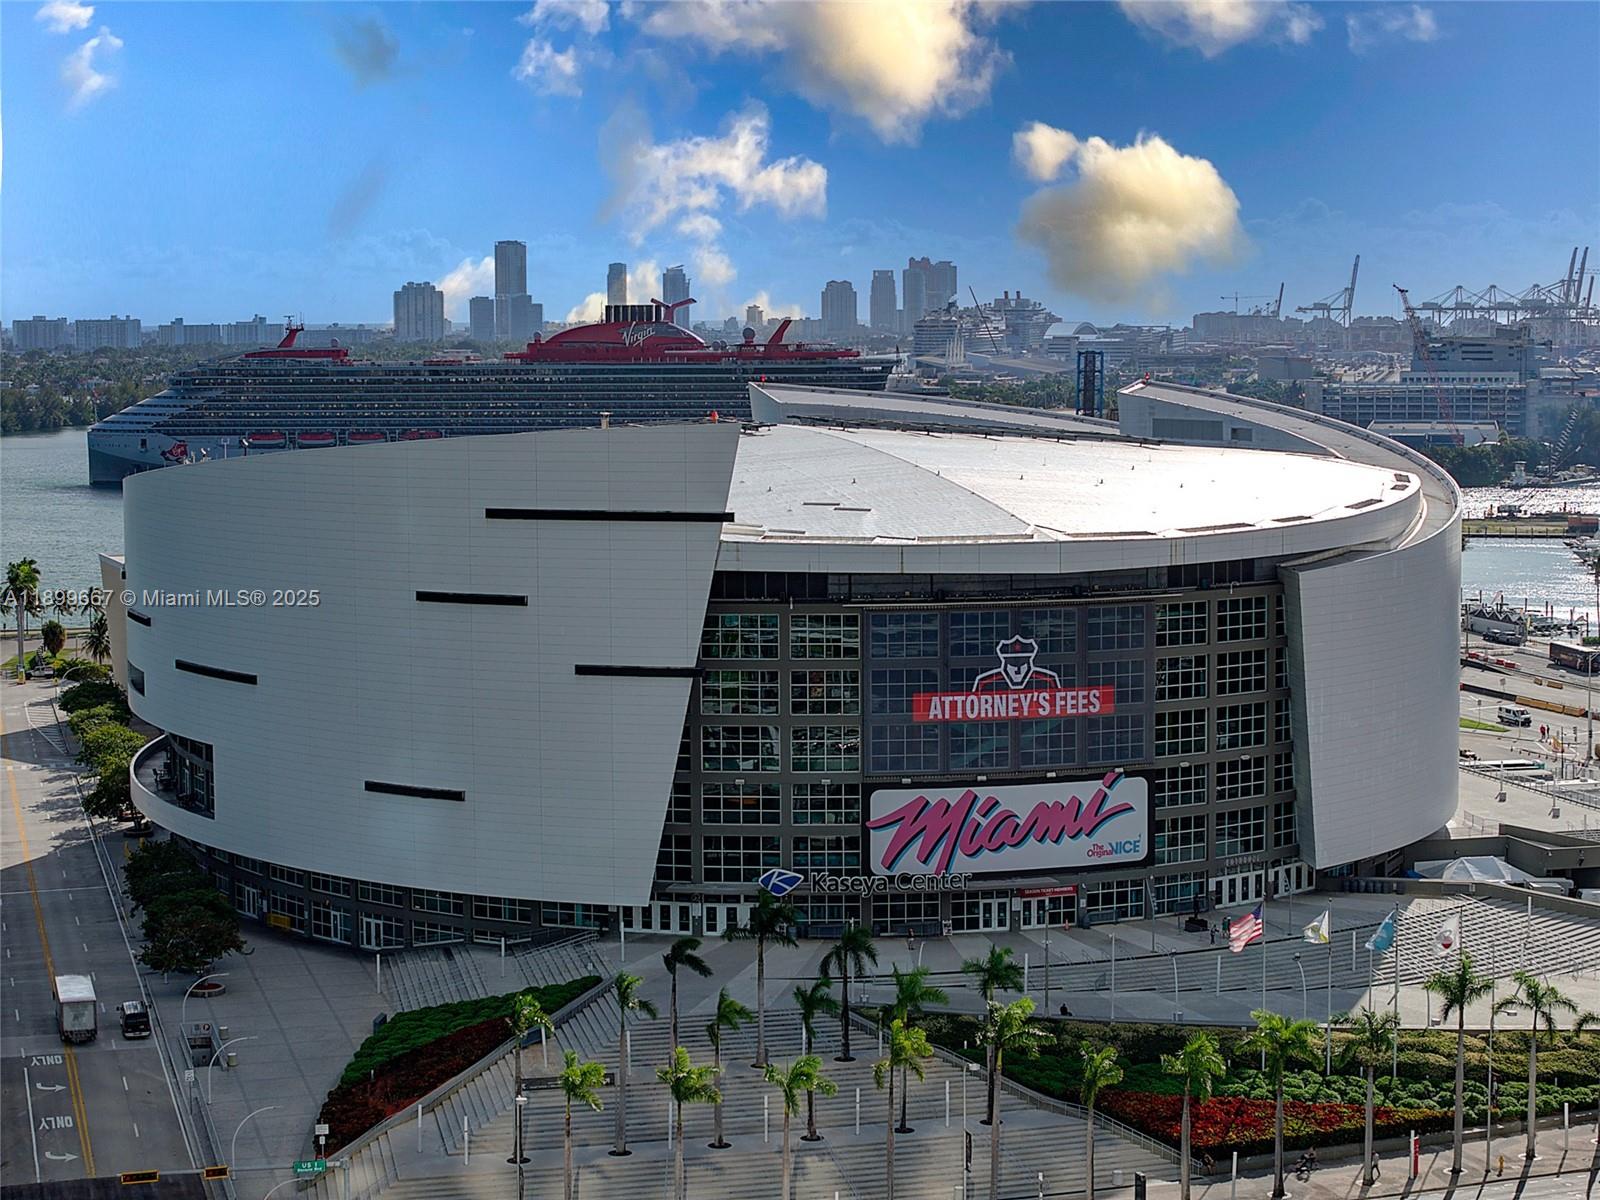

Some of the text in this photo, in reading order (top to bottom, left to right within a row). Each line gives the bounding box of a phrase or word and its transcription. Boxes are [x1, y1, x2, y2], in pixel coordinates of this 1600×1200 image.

[623, 321, 656, 347] Virgin
[928, 689, 1101, 720] ATTORNEY'S FEES
[866, 771, 1136, 876] Miami
[1092, 843, 1104, 851] The
[810, 871, 973, 897] Kaseya Center
[31, 1055, 63, 1067] ONLY
[39, 1116, 74, 1130] ONLY
